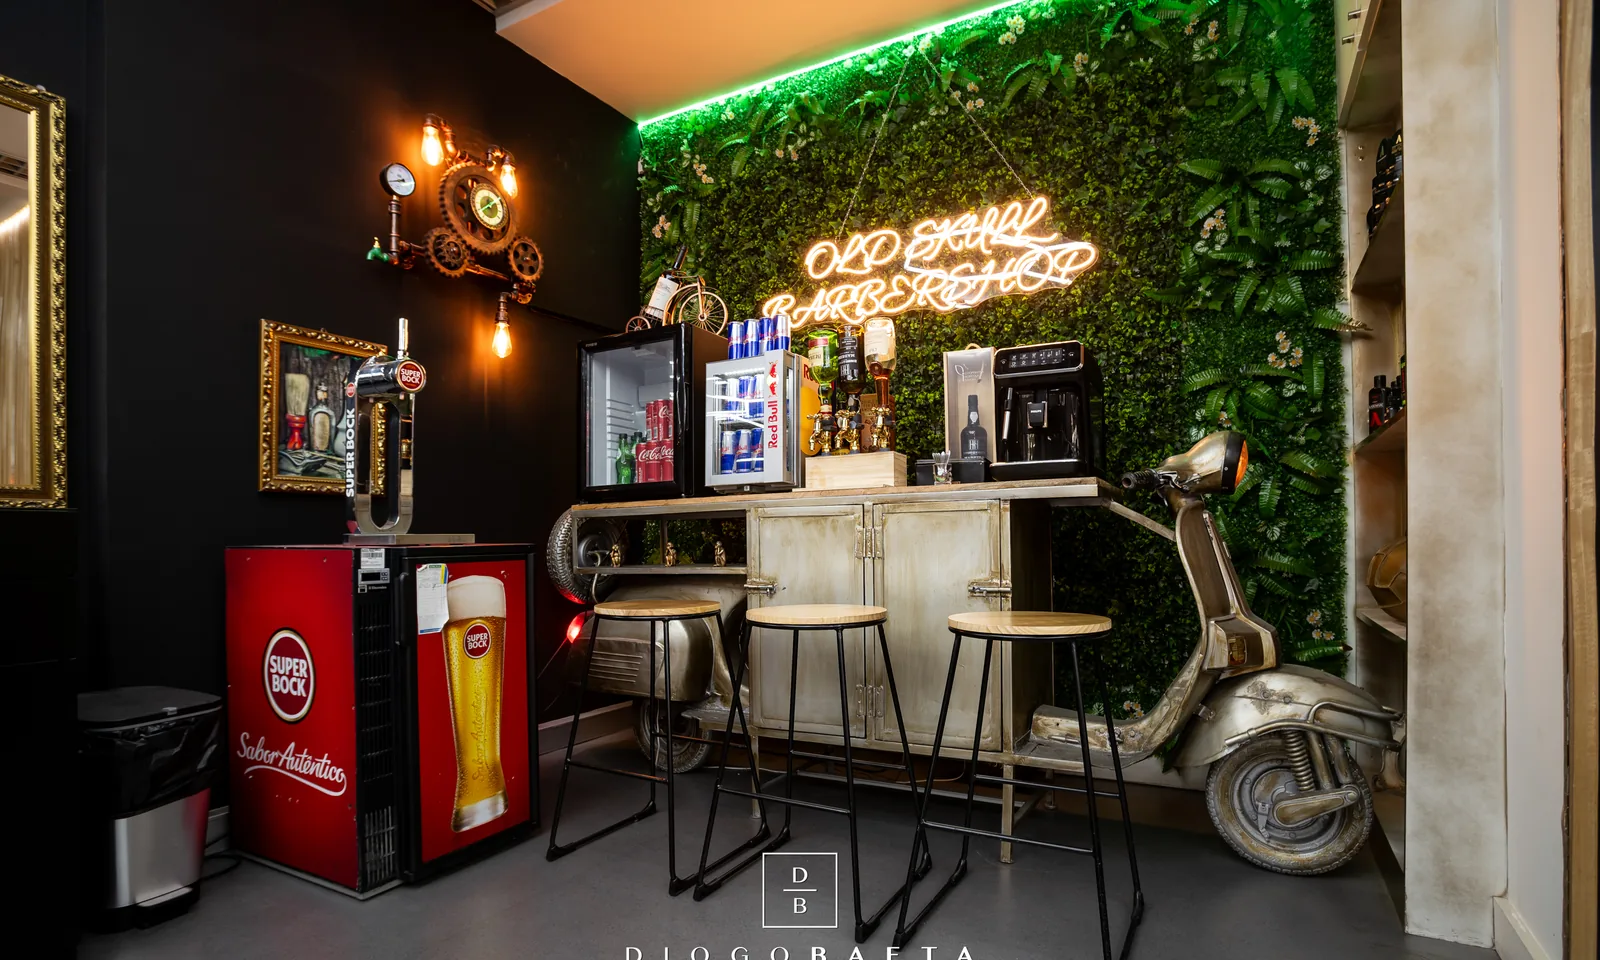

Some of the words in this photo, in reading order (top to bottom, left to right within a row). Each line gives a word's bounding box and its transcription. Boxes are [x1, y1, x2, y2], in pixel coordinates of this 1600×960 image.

[804, 229, 901, 280] OLD
[762, 243, 1097, 329] BARBERSHOP
[401, 368, 421, 377] SUPER
[402, 375, 420, 384] BOCK
[768, 400, 778, 423] Bull
[346, 407, 355, 450] BOCK
[768, 425, 778, 449] Red
[346, 451, 355, 498] SUPER
[467, 632, 489, 643] SUPER
[467, 640, 488, 650] BOCK
[269, 654, 308, 679] SUPER
[271, 673, 307, 698] BOCK
[236, 732, 279, 765] Sabor
[277, 741, 347, 784] Autêntico
